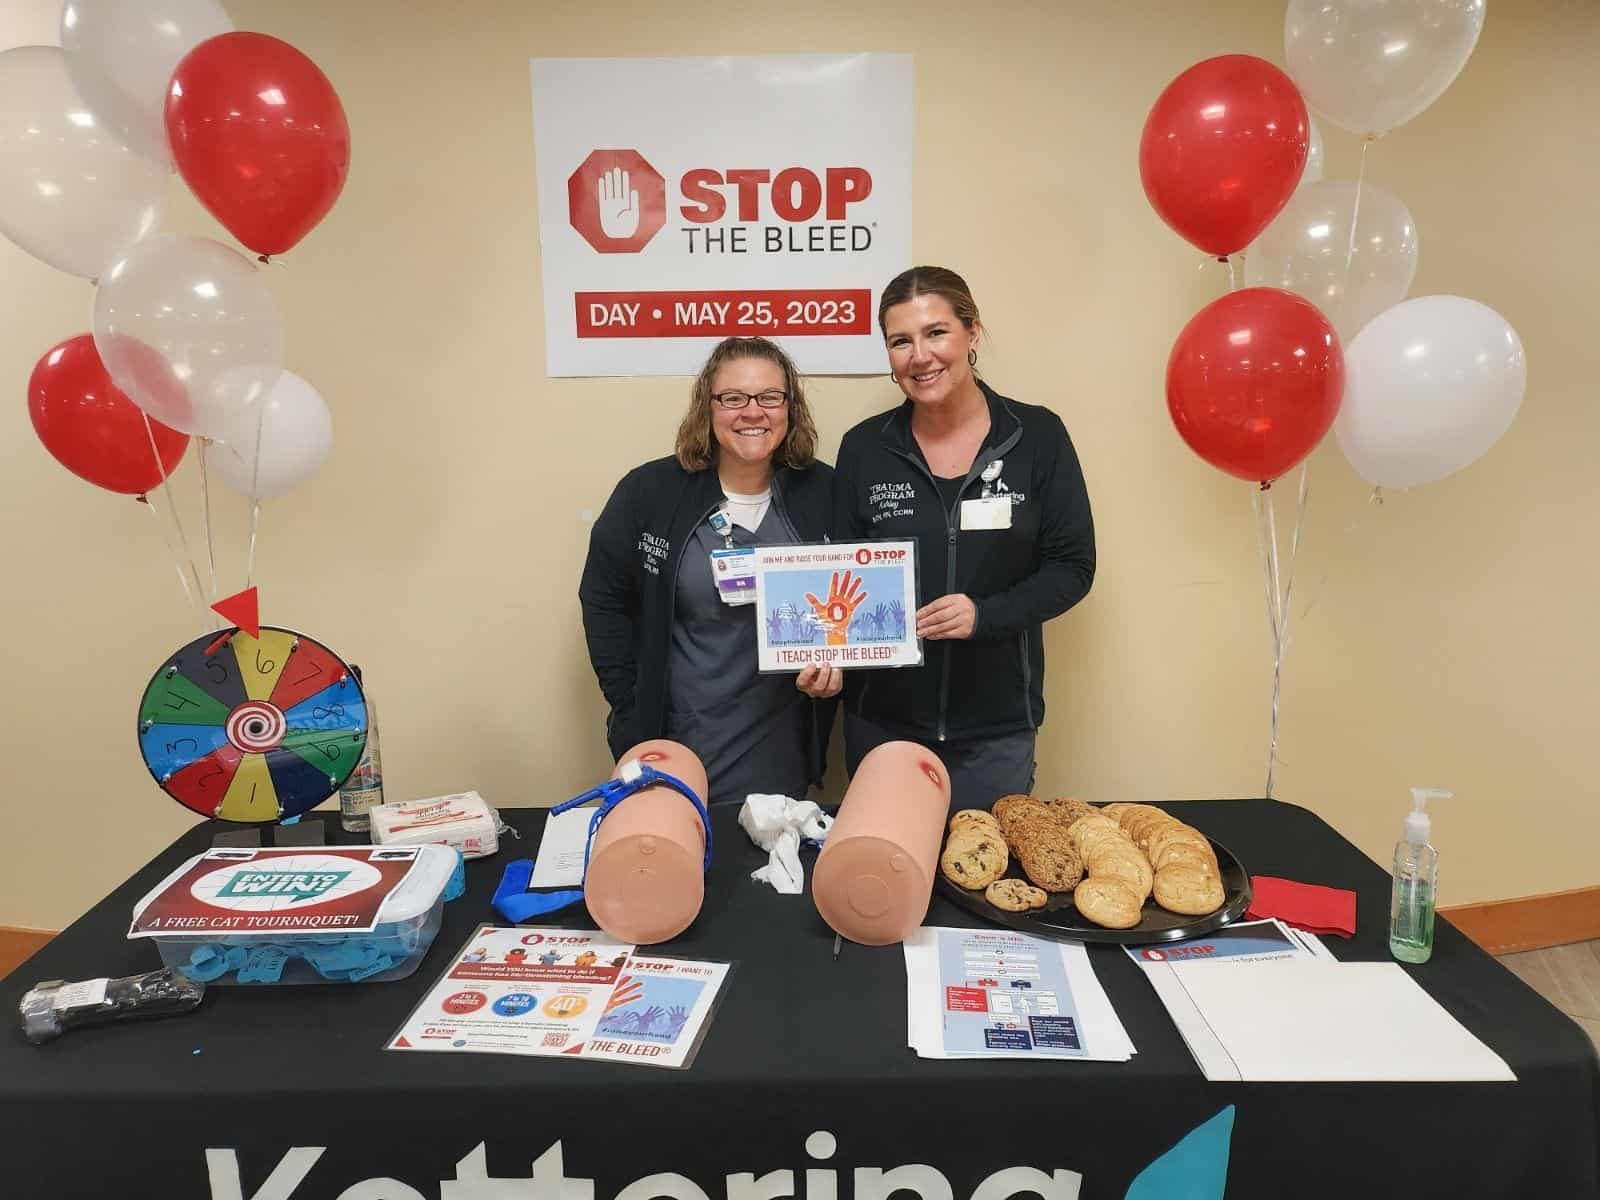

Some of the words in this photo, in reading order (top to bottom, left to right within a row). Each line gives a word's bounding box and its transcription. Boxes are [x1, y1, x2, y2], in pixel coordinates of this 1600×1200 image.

[680, 167, 873, 223] STOP
[681, 227, 747, 254] THE
[589, 303, 641, 327] DAY
[674, 302, 731, 326] MAY
[737, 301, 779, 329] 25,
[786, 300, 856, 325] 2023
[874, 550, 906, 560] STOP
[256, 648, 275, 674] 6
[782, 650, 812, 664] TEACH
[815, 648, 839, 662] STOP
[841, 648, 859, 661] THE
[206, 656, 229, 685] 5
[292, 662, 323, 687] 7
[163, 691, 201, 710] 4
[312, 703, 345, 720] 8
[166, 738, 199, 755] 3
[198, 763, 224, 789] 2
[250, 782, 257, 804] 1
[241, 874, 308, 882] ENTER
[312, 874, 338, 882] TO
[231, 881, 328, 893] WIN!
[149, 917, 162, 928] A
[164, 917, 208, 928] FREE
[210, 916, 245, 928] CAT
[247, 914, 360, 928] TOURNIQUET!
[1168, 945, 1215, 957] STOP
[634, 962, 675, 971] STOP
[589, 1040, 616, 1053] THE
